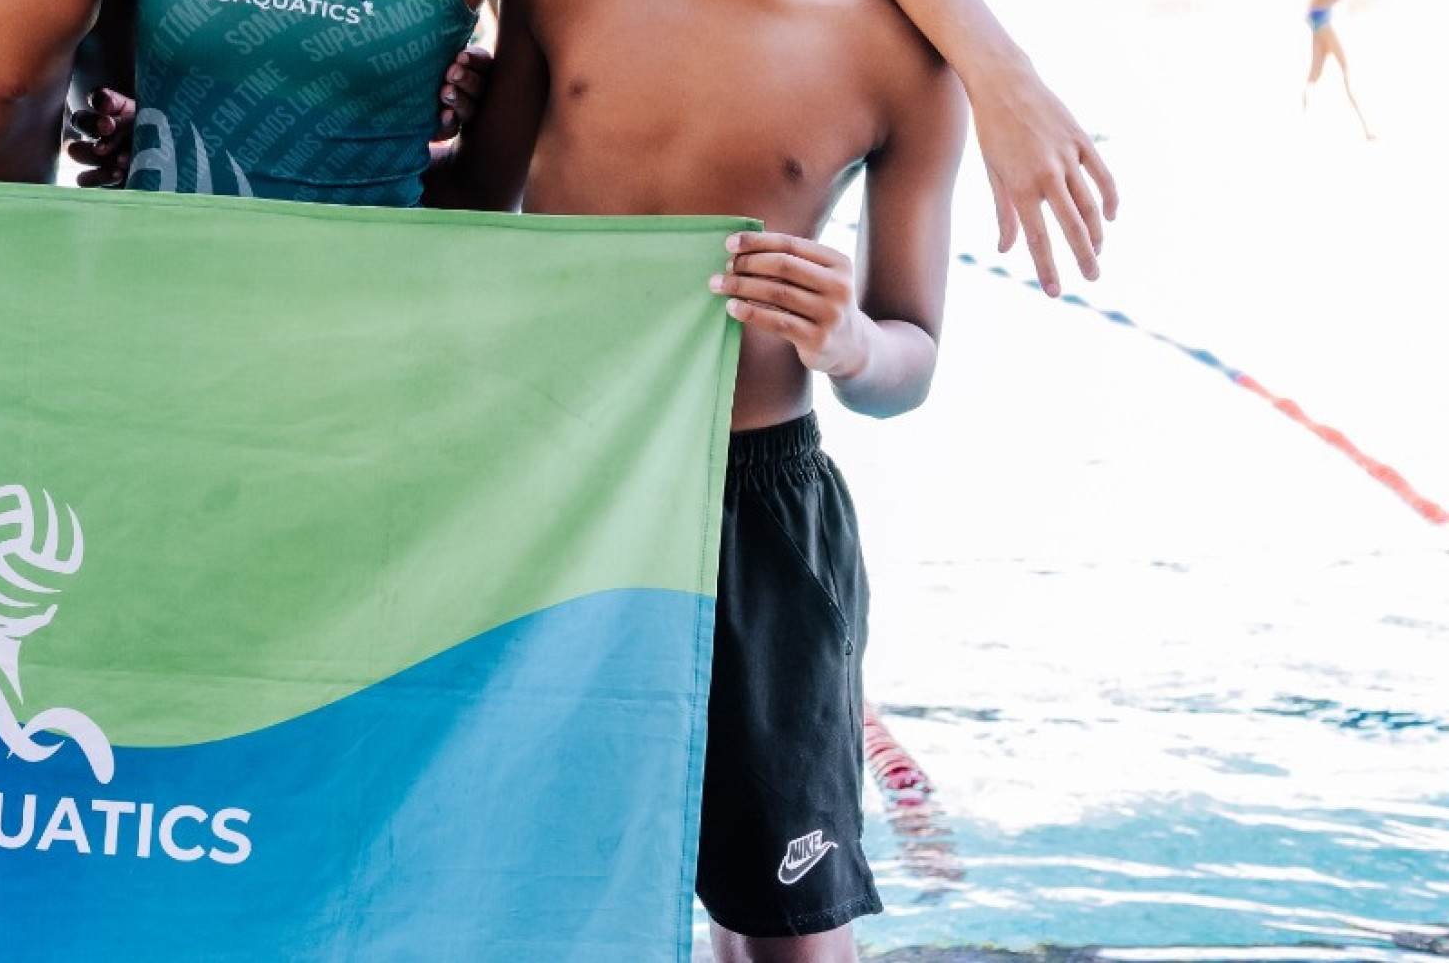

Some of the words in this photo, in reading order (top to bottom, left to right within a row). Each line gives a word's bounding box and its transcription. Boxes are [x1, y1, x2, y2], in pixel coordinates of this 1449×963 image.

[234, 60, 290, 107] TIME
[286, 69, 351, 116] LIMPO
[785, 830, 824, 870] NIKE
